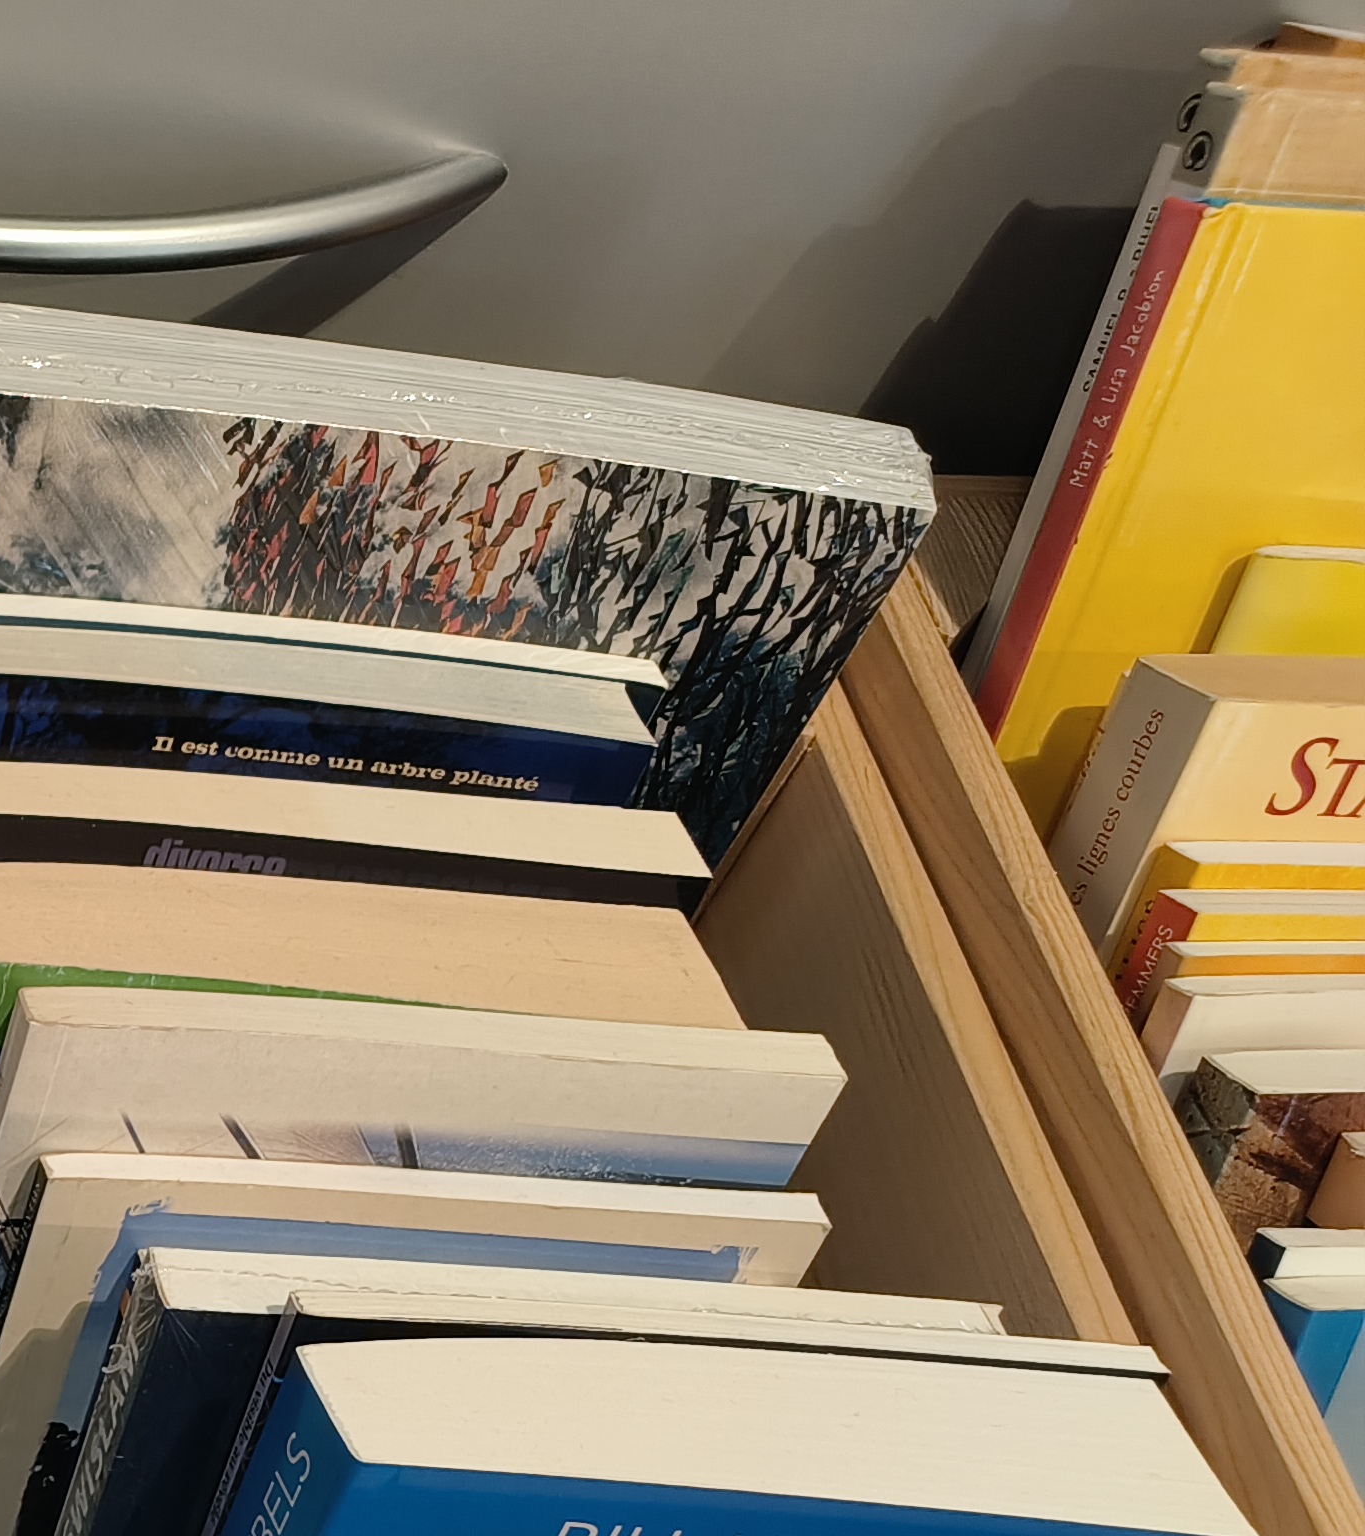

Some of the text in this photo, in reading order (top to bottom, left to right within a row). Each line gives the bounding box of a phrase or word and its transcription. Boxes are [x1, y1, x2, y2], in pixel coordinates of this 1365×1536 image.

[1119, 269, 1166, 357] Jacobson
[1101, 367, 1127, 404] Lisa
[1092, 414, 1112, 430] &
[1069, 438, 1099, 489] Matt
[151, 735, 541, 793] Il est comme un arbre planté
[1076, 806, 1122, 877] lignes
[1115, 708, 1165, 802] courbes
